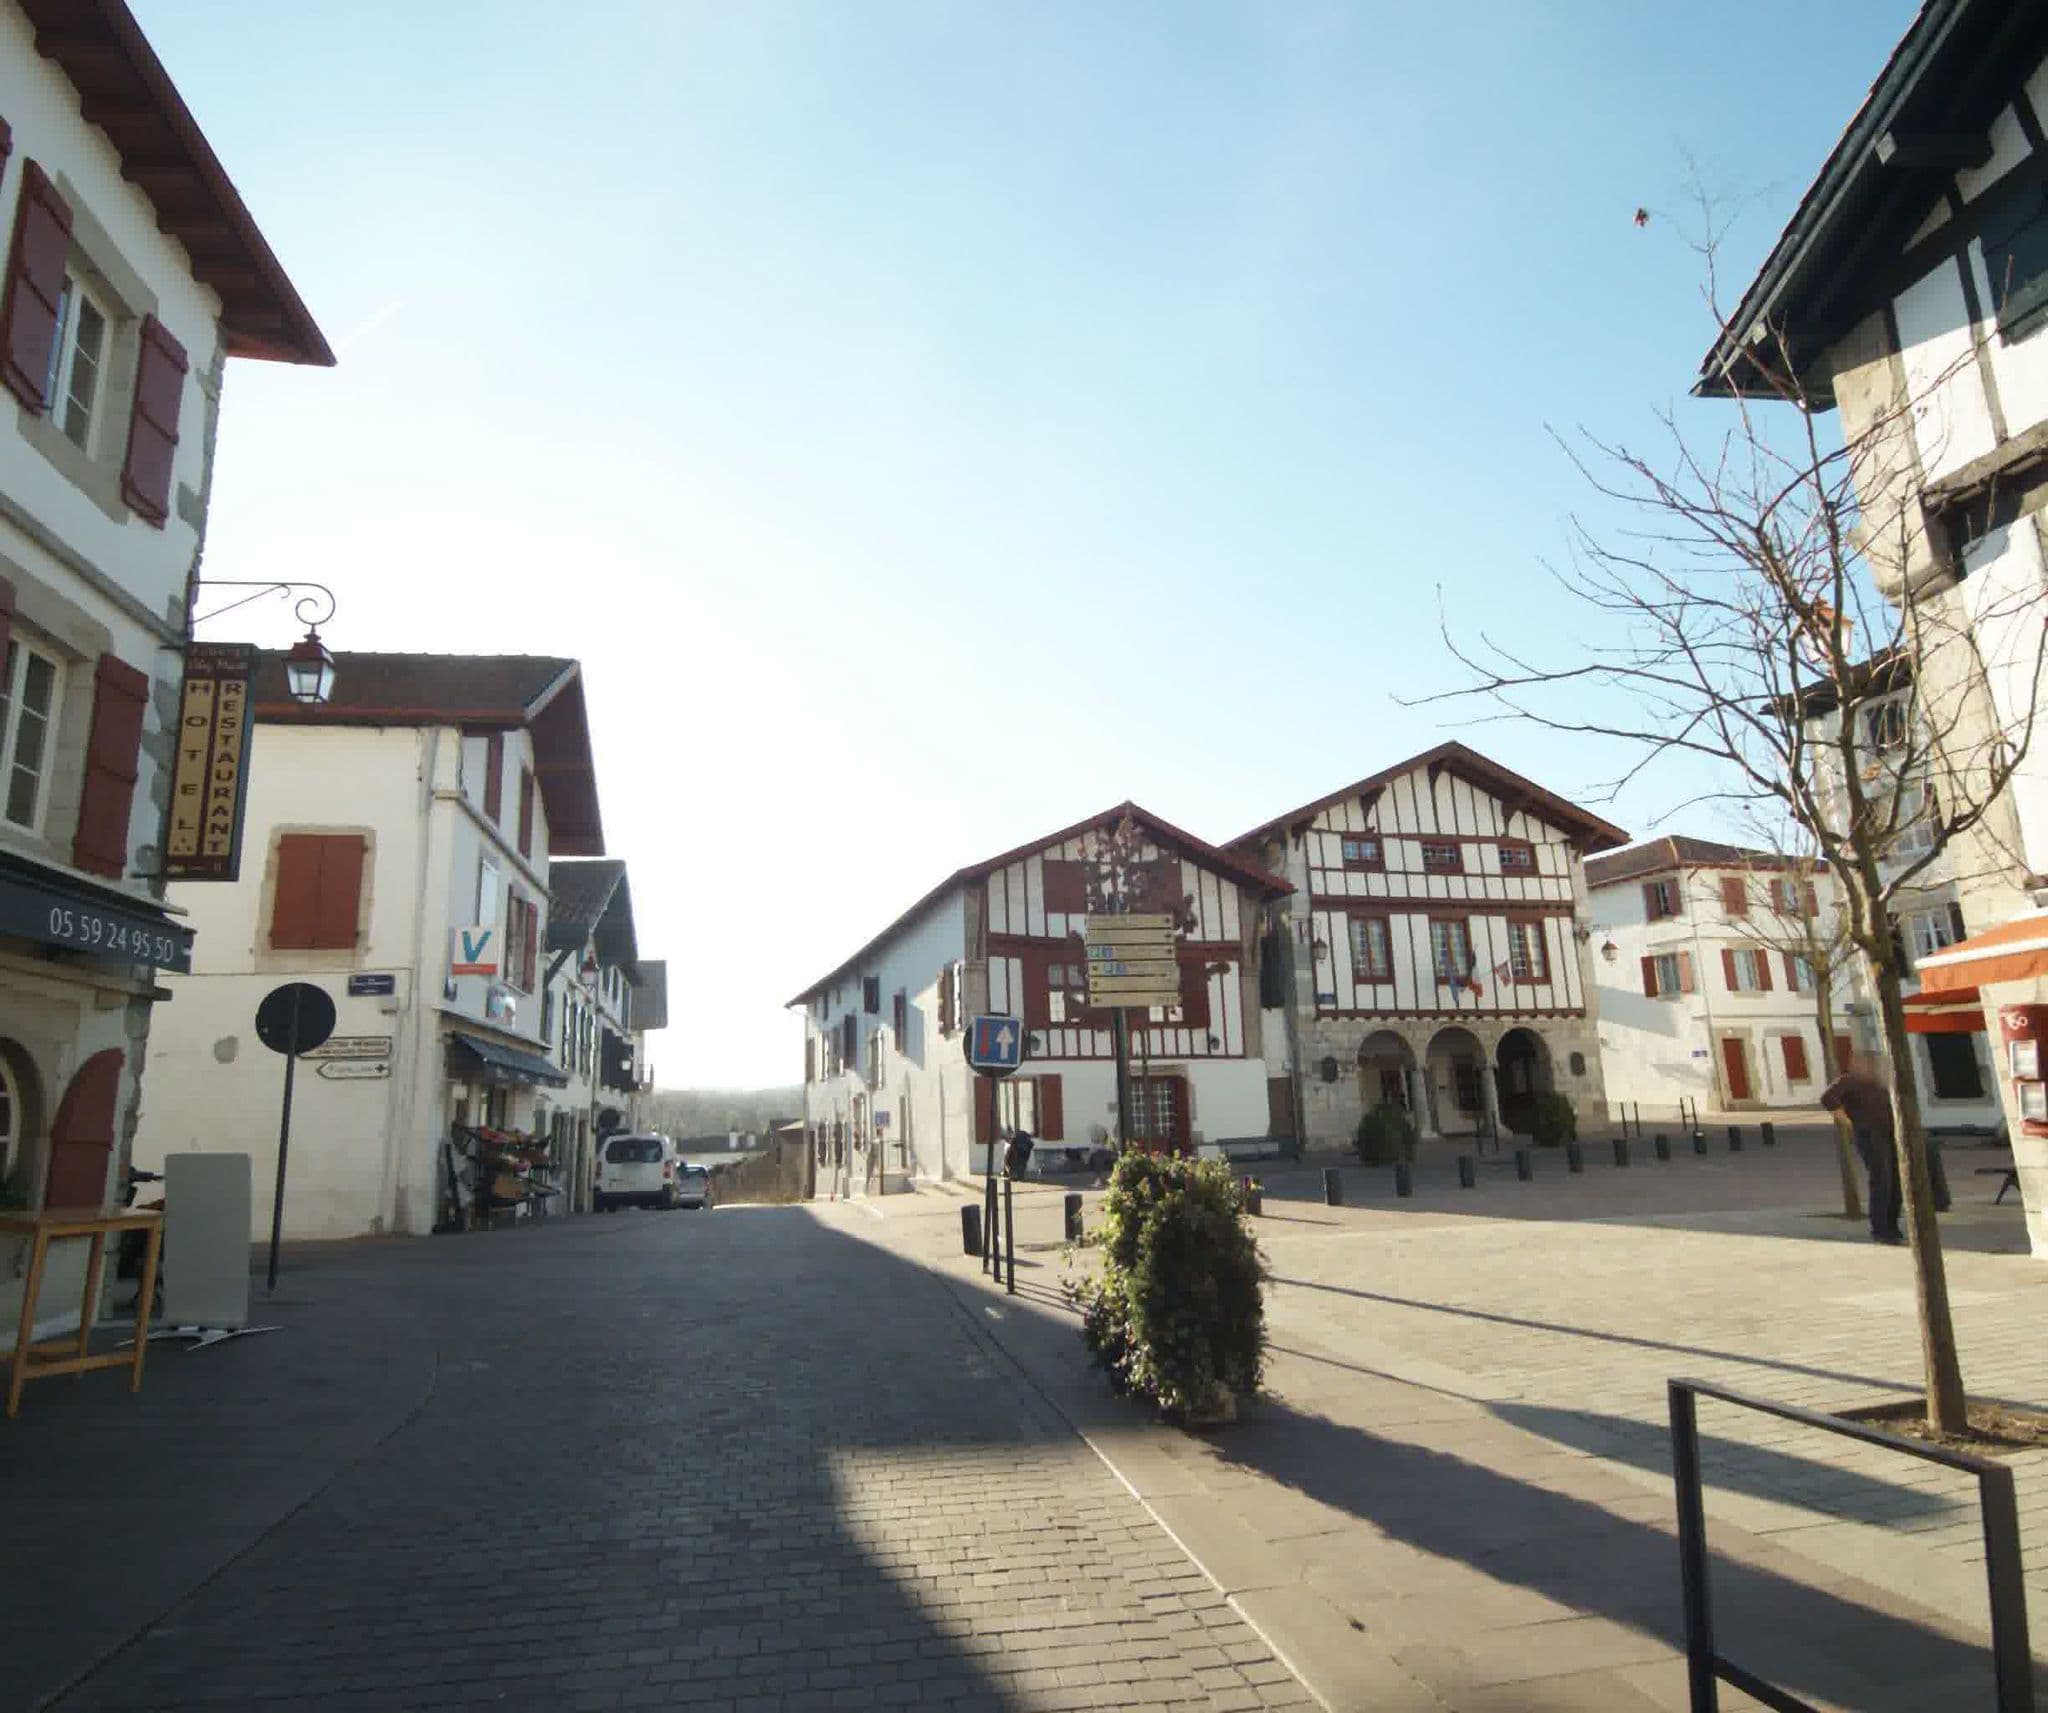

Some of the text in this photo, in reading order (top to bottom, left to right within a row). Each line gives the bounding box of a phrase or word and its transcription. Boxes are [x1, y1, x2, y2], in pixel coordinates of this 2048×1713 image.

[177, 682, 210, 831] HOTEL
[208, 683, 242, 853] RESTAURANT
[50, 907, 175, 963] 05 59 24 95 50
